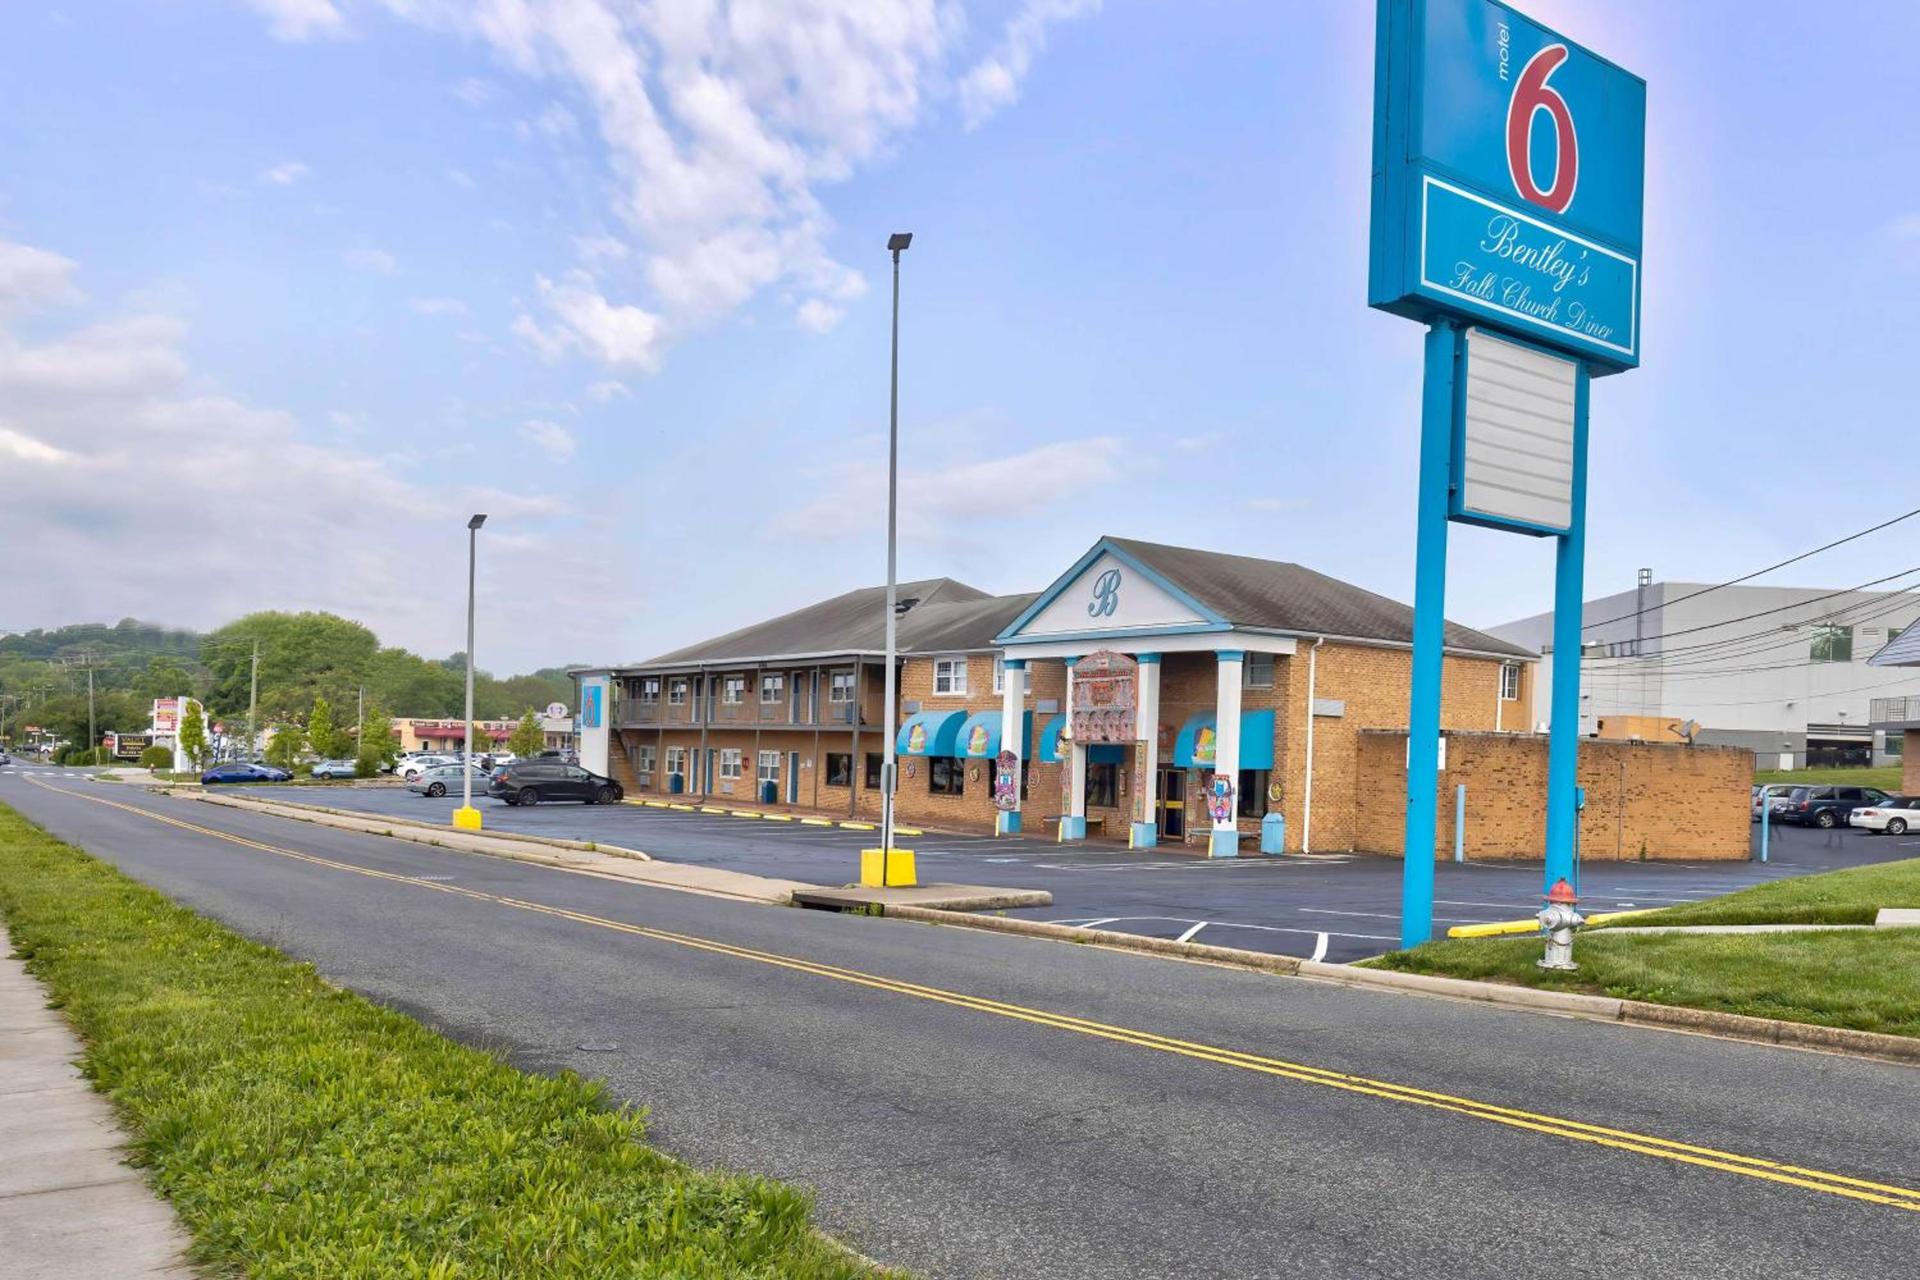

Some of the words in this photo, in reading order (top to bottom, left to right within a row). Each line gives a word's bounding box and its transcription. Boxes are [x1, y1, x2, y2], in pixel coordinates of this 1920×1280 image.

[1498, 22, 1510, 81] motel
[1505, 43, 1579, 215] 6
[1480, 214, 1592, 293] Bentley's
[1450, 261, 1498, 300] Falls
[1501, 277, 1561, 321] Church
[1565, 301, 1615, 339] Diner
[1088, 568, 1121, 617] B
